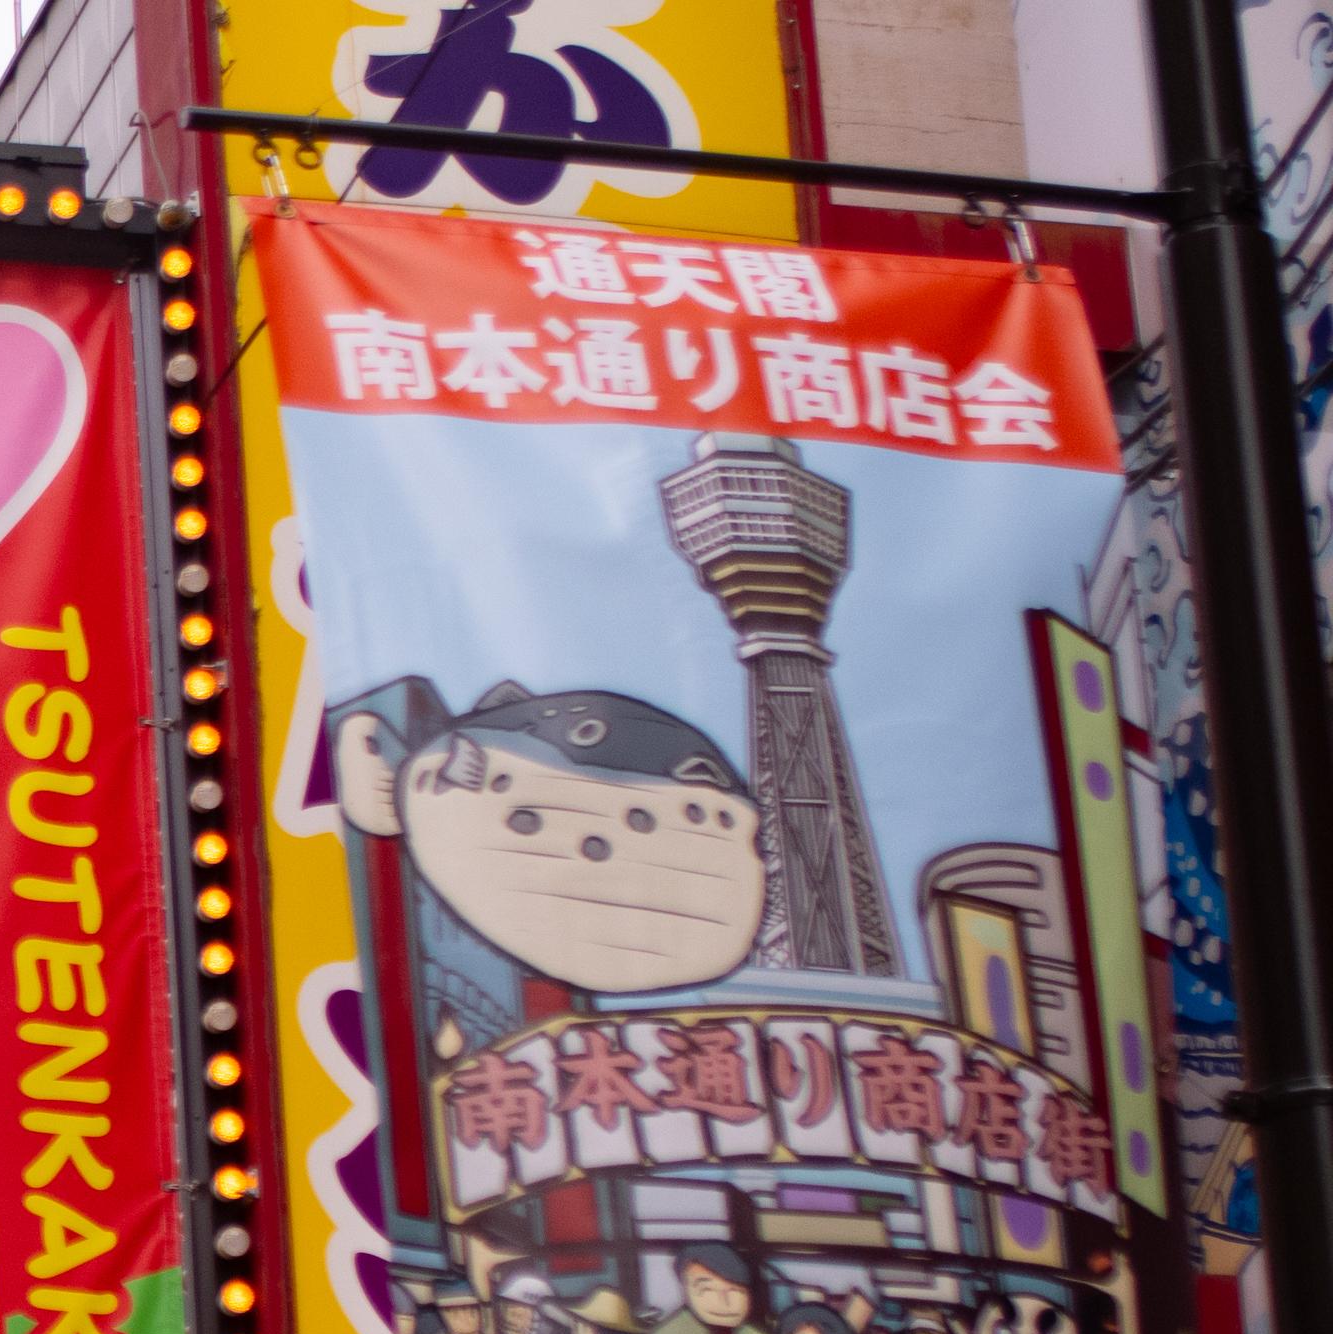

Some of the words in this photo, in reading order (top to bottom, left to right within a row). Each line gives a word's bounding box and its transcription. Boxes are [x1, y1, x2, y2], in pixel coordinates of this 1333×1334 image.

[520, 227, 837, 324] 通天閣
[327, 307, 1060, 452] 南本通り商店会
[448, 1016, 1114, 1194] 南本通り商店街
